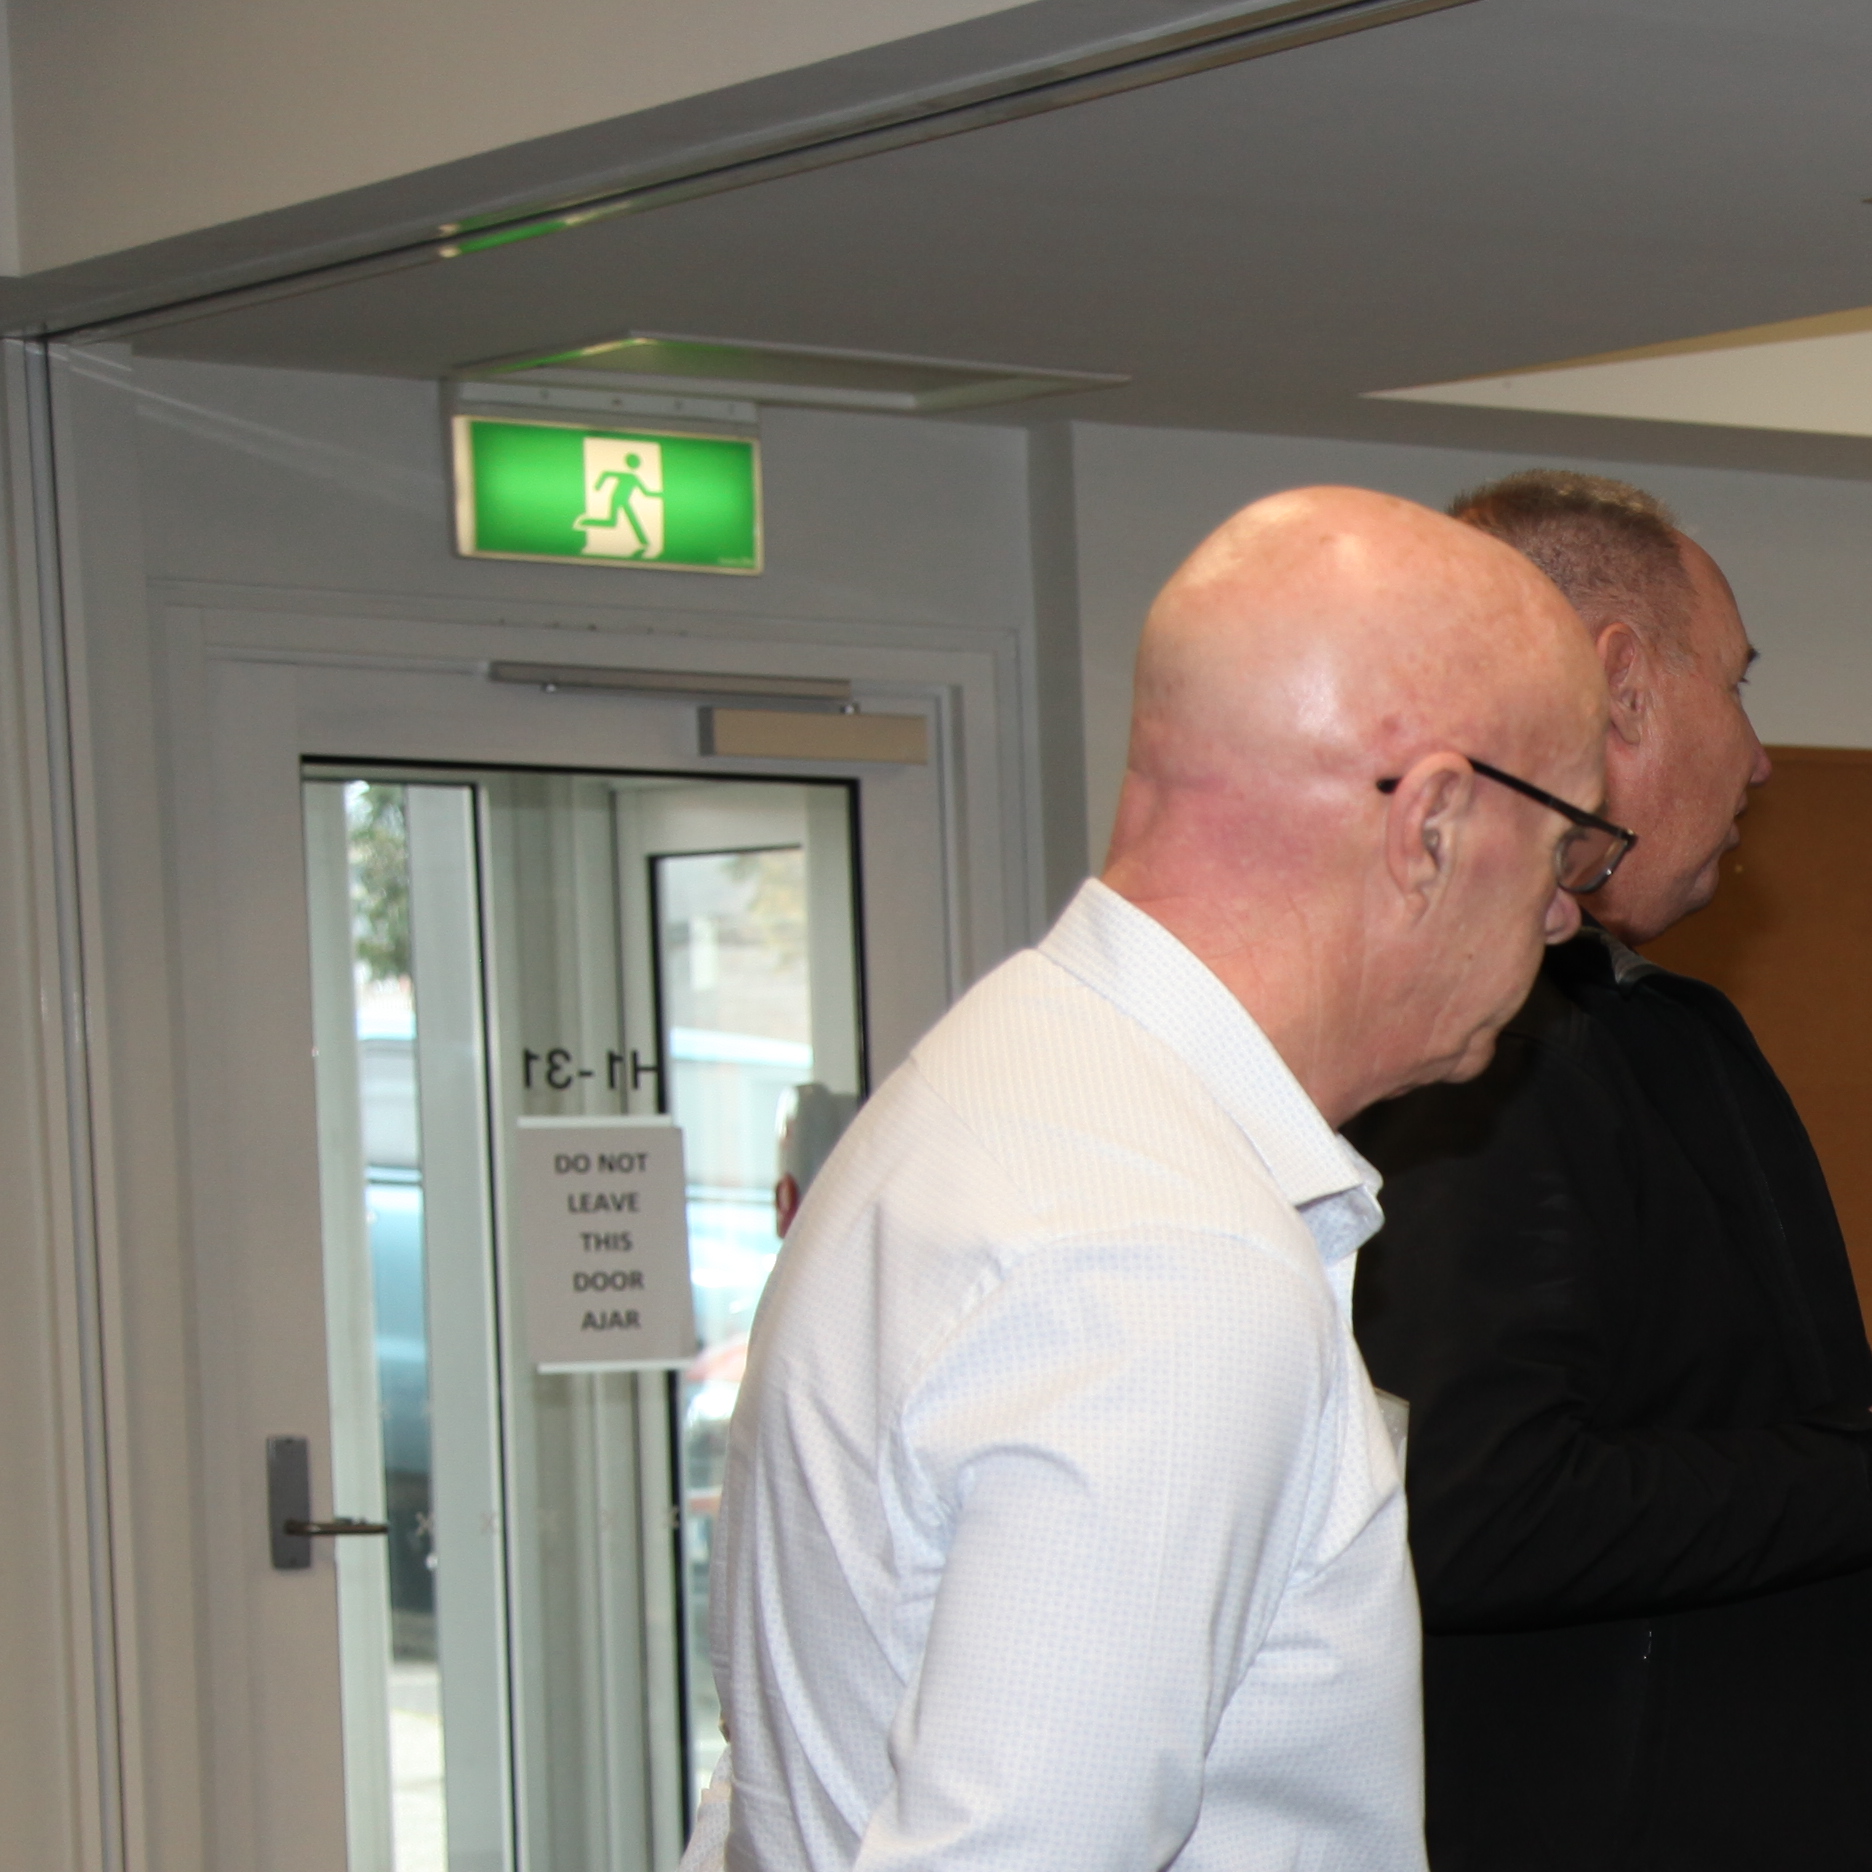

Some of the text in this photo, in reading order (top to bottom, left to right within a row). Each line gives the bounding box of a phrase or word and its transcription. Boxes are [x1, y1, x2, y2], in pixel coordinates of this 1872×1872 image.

[554, 1153, 648, 1174] DO NOT
[567, 1193, 640, 1213] LEAVE
[580, 1232, 632, 1251] THIS
[572, 1271, 645, 1293] DOOR
[581, 1310, 641, 1331] AJAR
